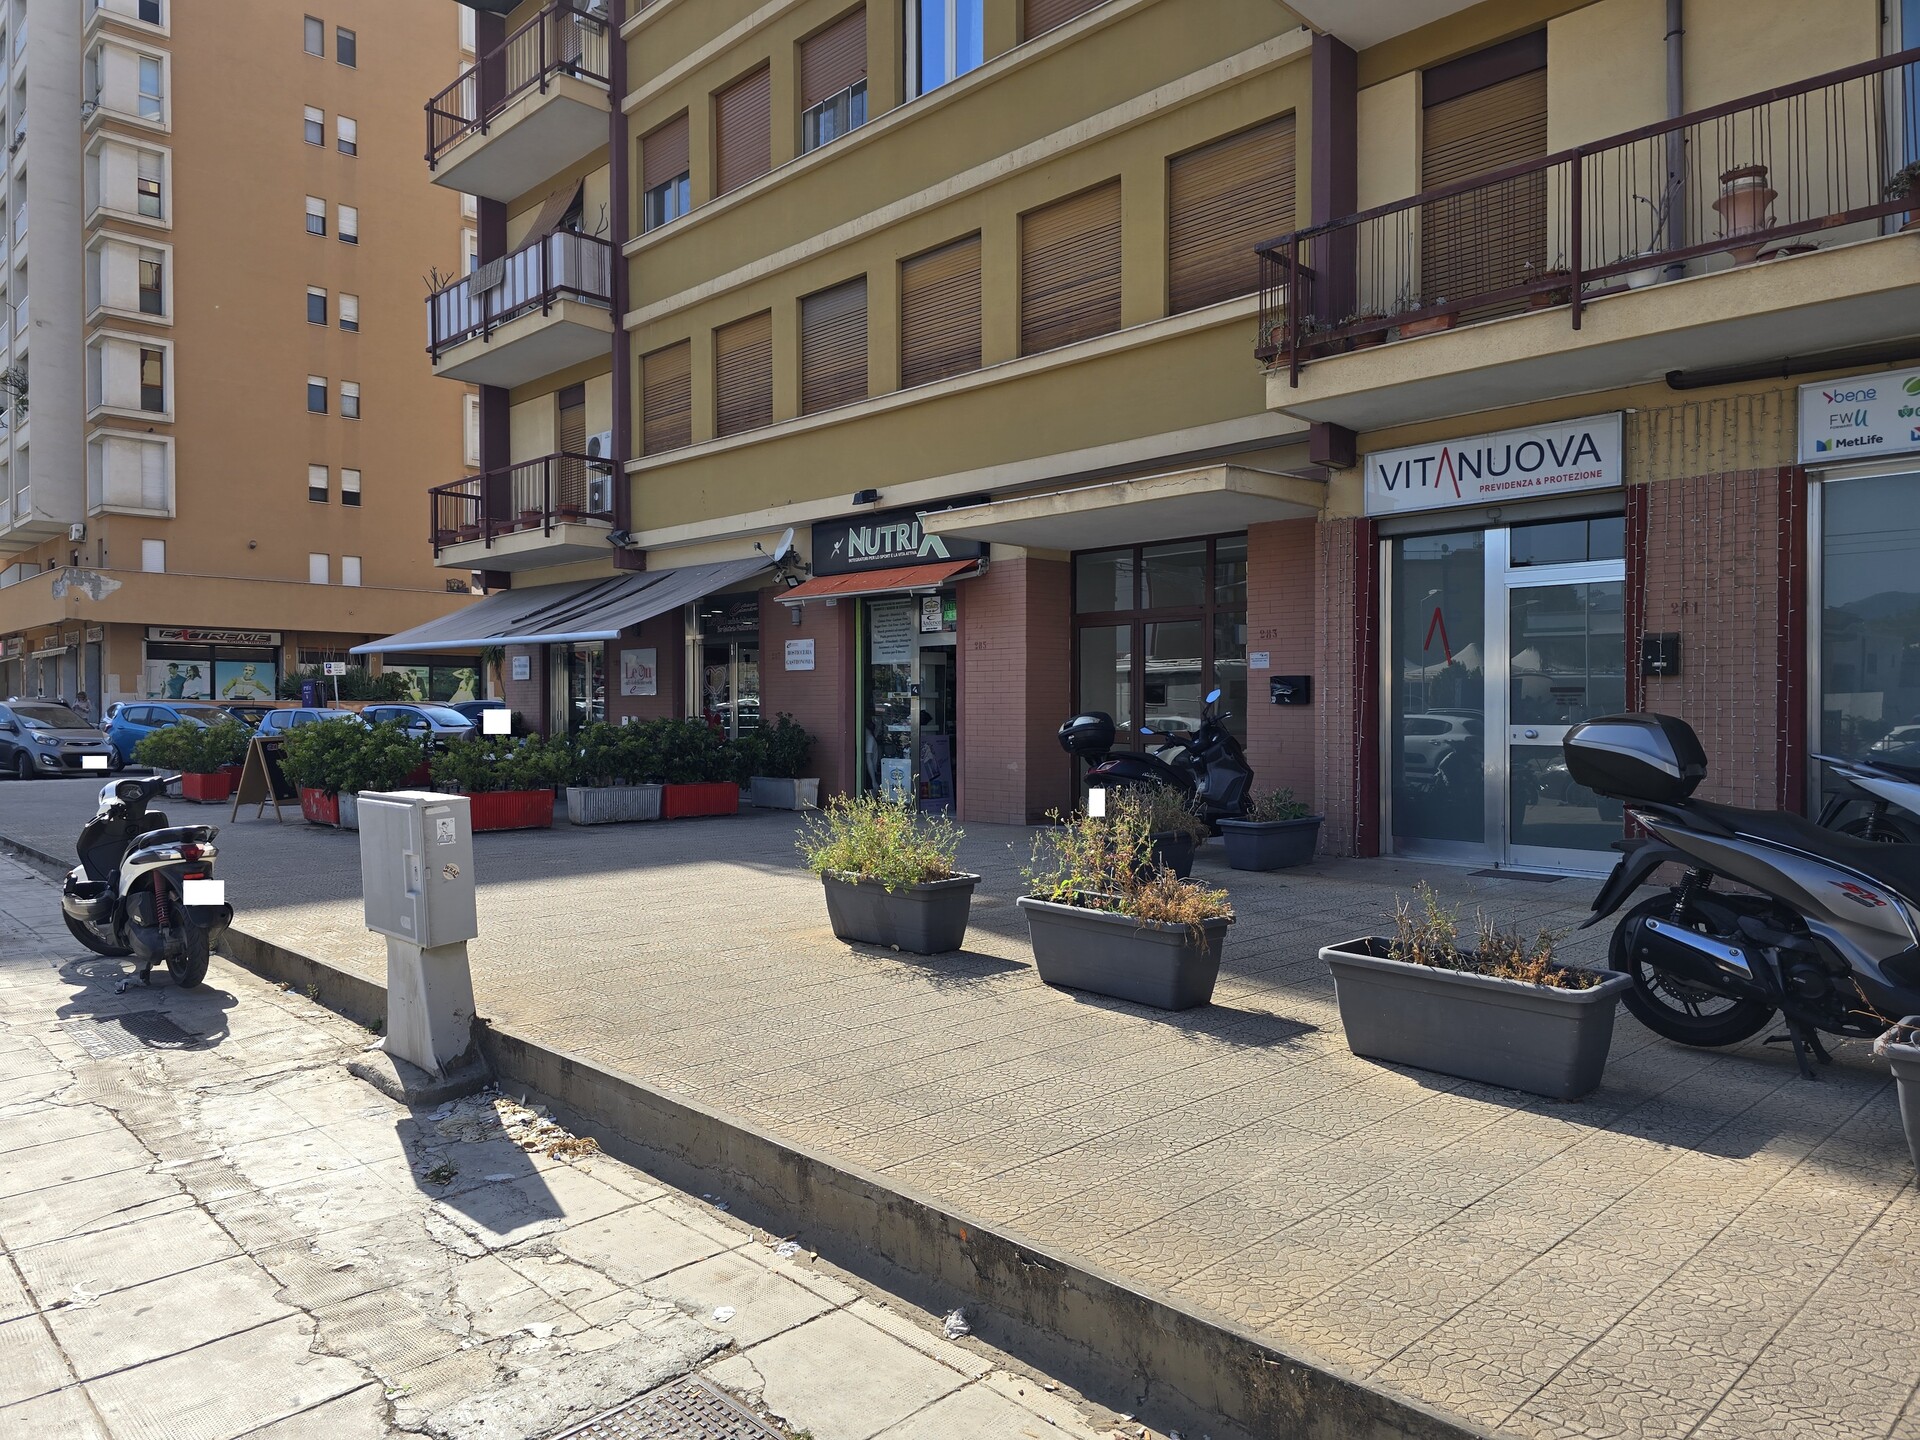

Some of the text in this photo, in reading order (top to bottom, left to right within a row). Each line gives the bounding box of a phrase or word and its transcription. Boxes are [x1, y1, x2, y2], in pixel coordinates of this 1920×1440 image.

[1834, 388, 1877, 403] bene
[1835, 434, 1884, 448] MetLife
[1479, 469, 1603, 493] PREVIDENZA & PROTEZIONE
[160, 629, 270, 642] EXTREME
[1259, 629, 1278, 639] 283
